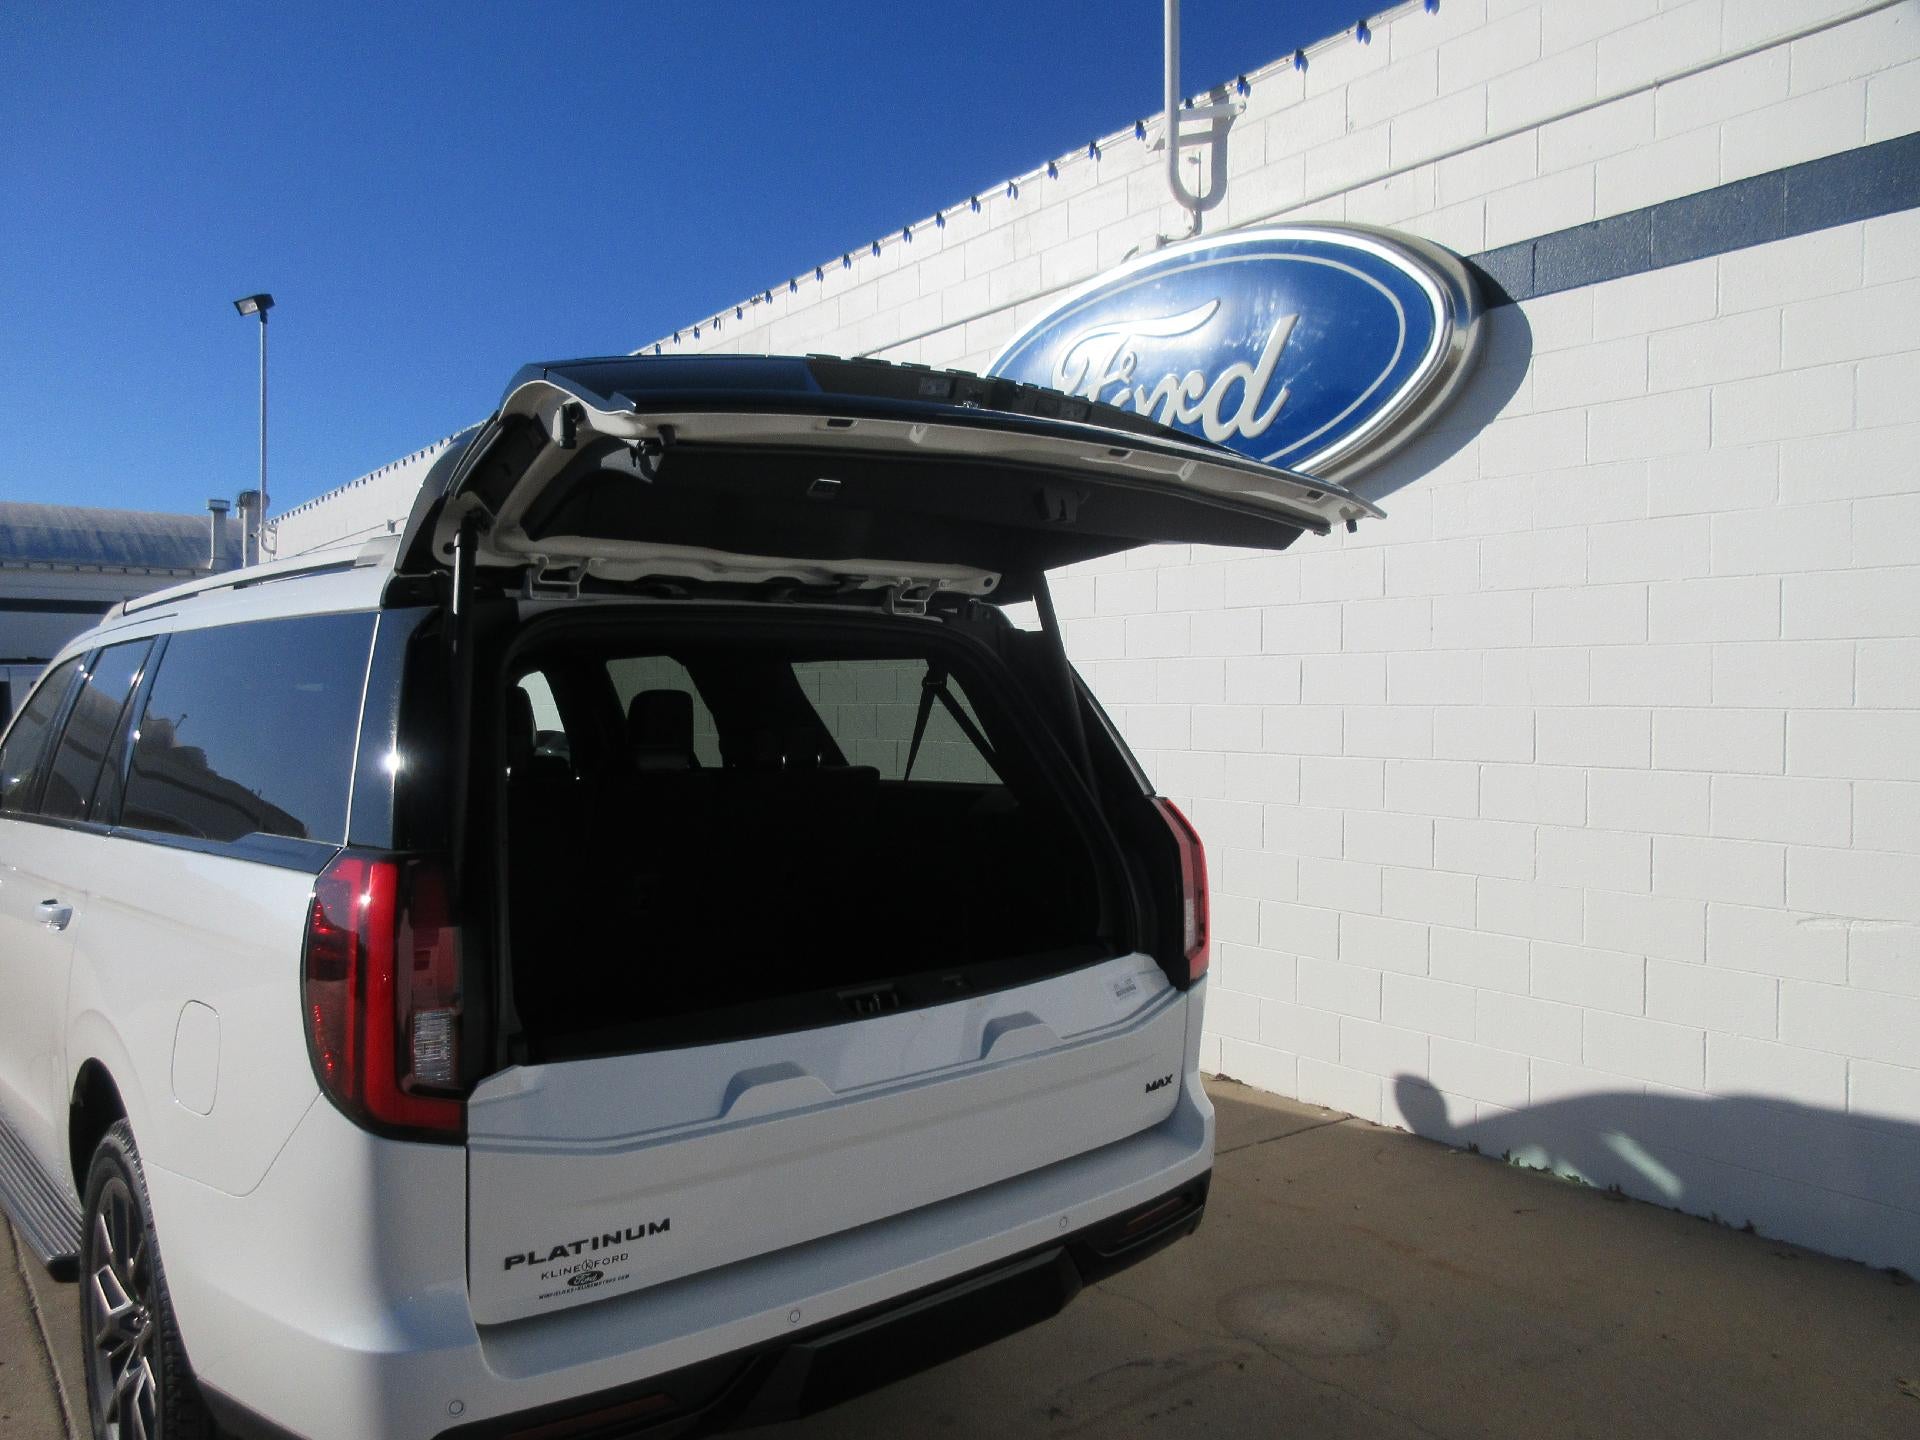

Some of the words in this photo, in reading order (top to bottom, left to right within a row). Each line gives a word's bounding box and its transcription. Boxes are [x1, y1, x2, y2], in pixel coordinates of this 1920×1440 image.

[1145, 1074, 1173, 1093] MAX
[504, 1217, 671, 1270] PLATINUM
[541, 1264, 581, 1280] KLINE
[594, 1253, 629, 1269] FORD
